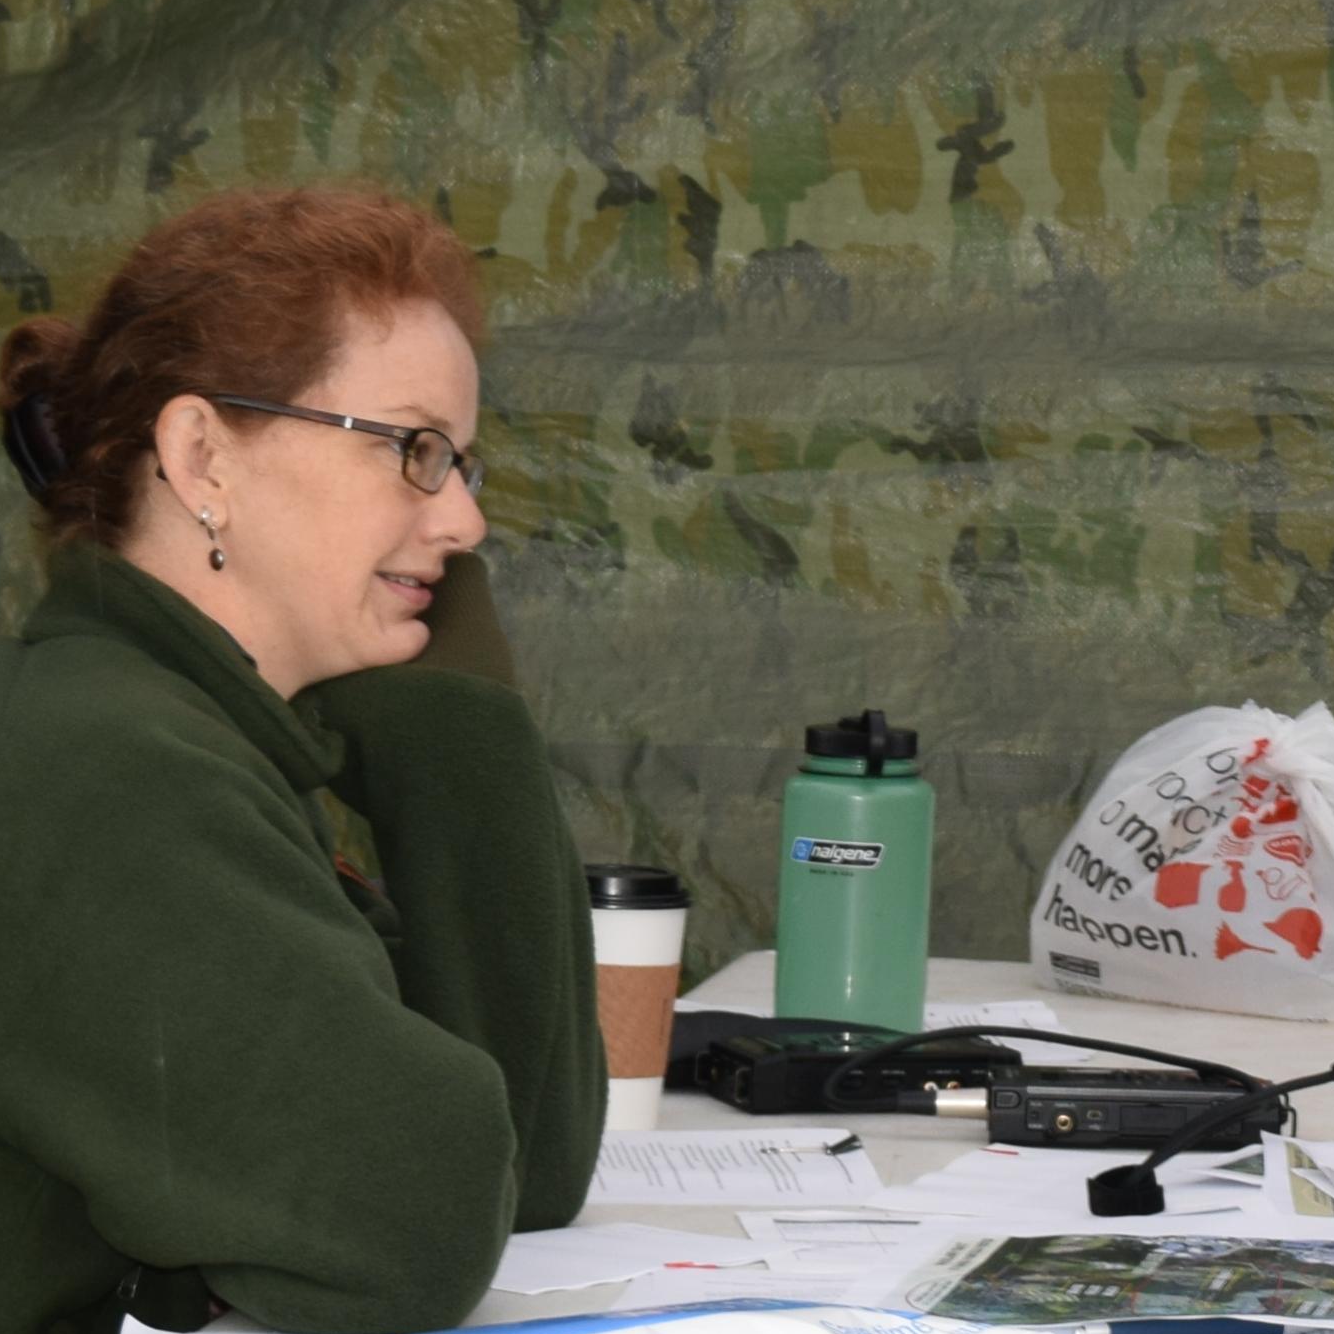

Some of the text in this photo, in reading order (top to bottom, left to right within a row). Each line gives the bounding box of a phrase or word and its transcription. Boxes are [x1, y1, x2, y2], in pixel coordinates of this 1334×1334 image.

[811, 845, 880, 863] nalgene
[1065, 842, 1132, 901] more
[1044, 884, 1197, 958] happen.
